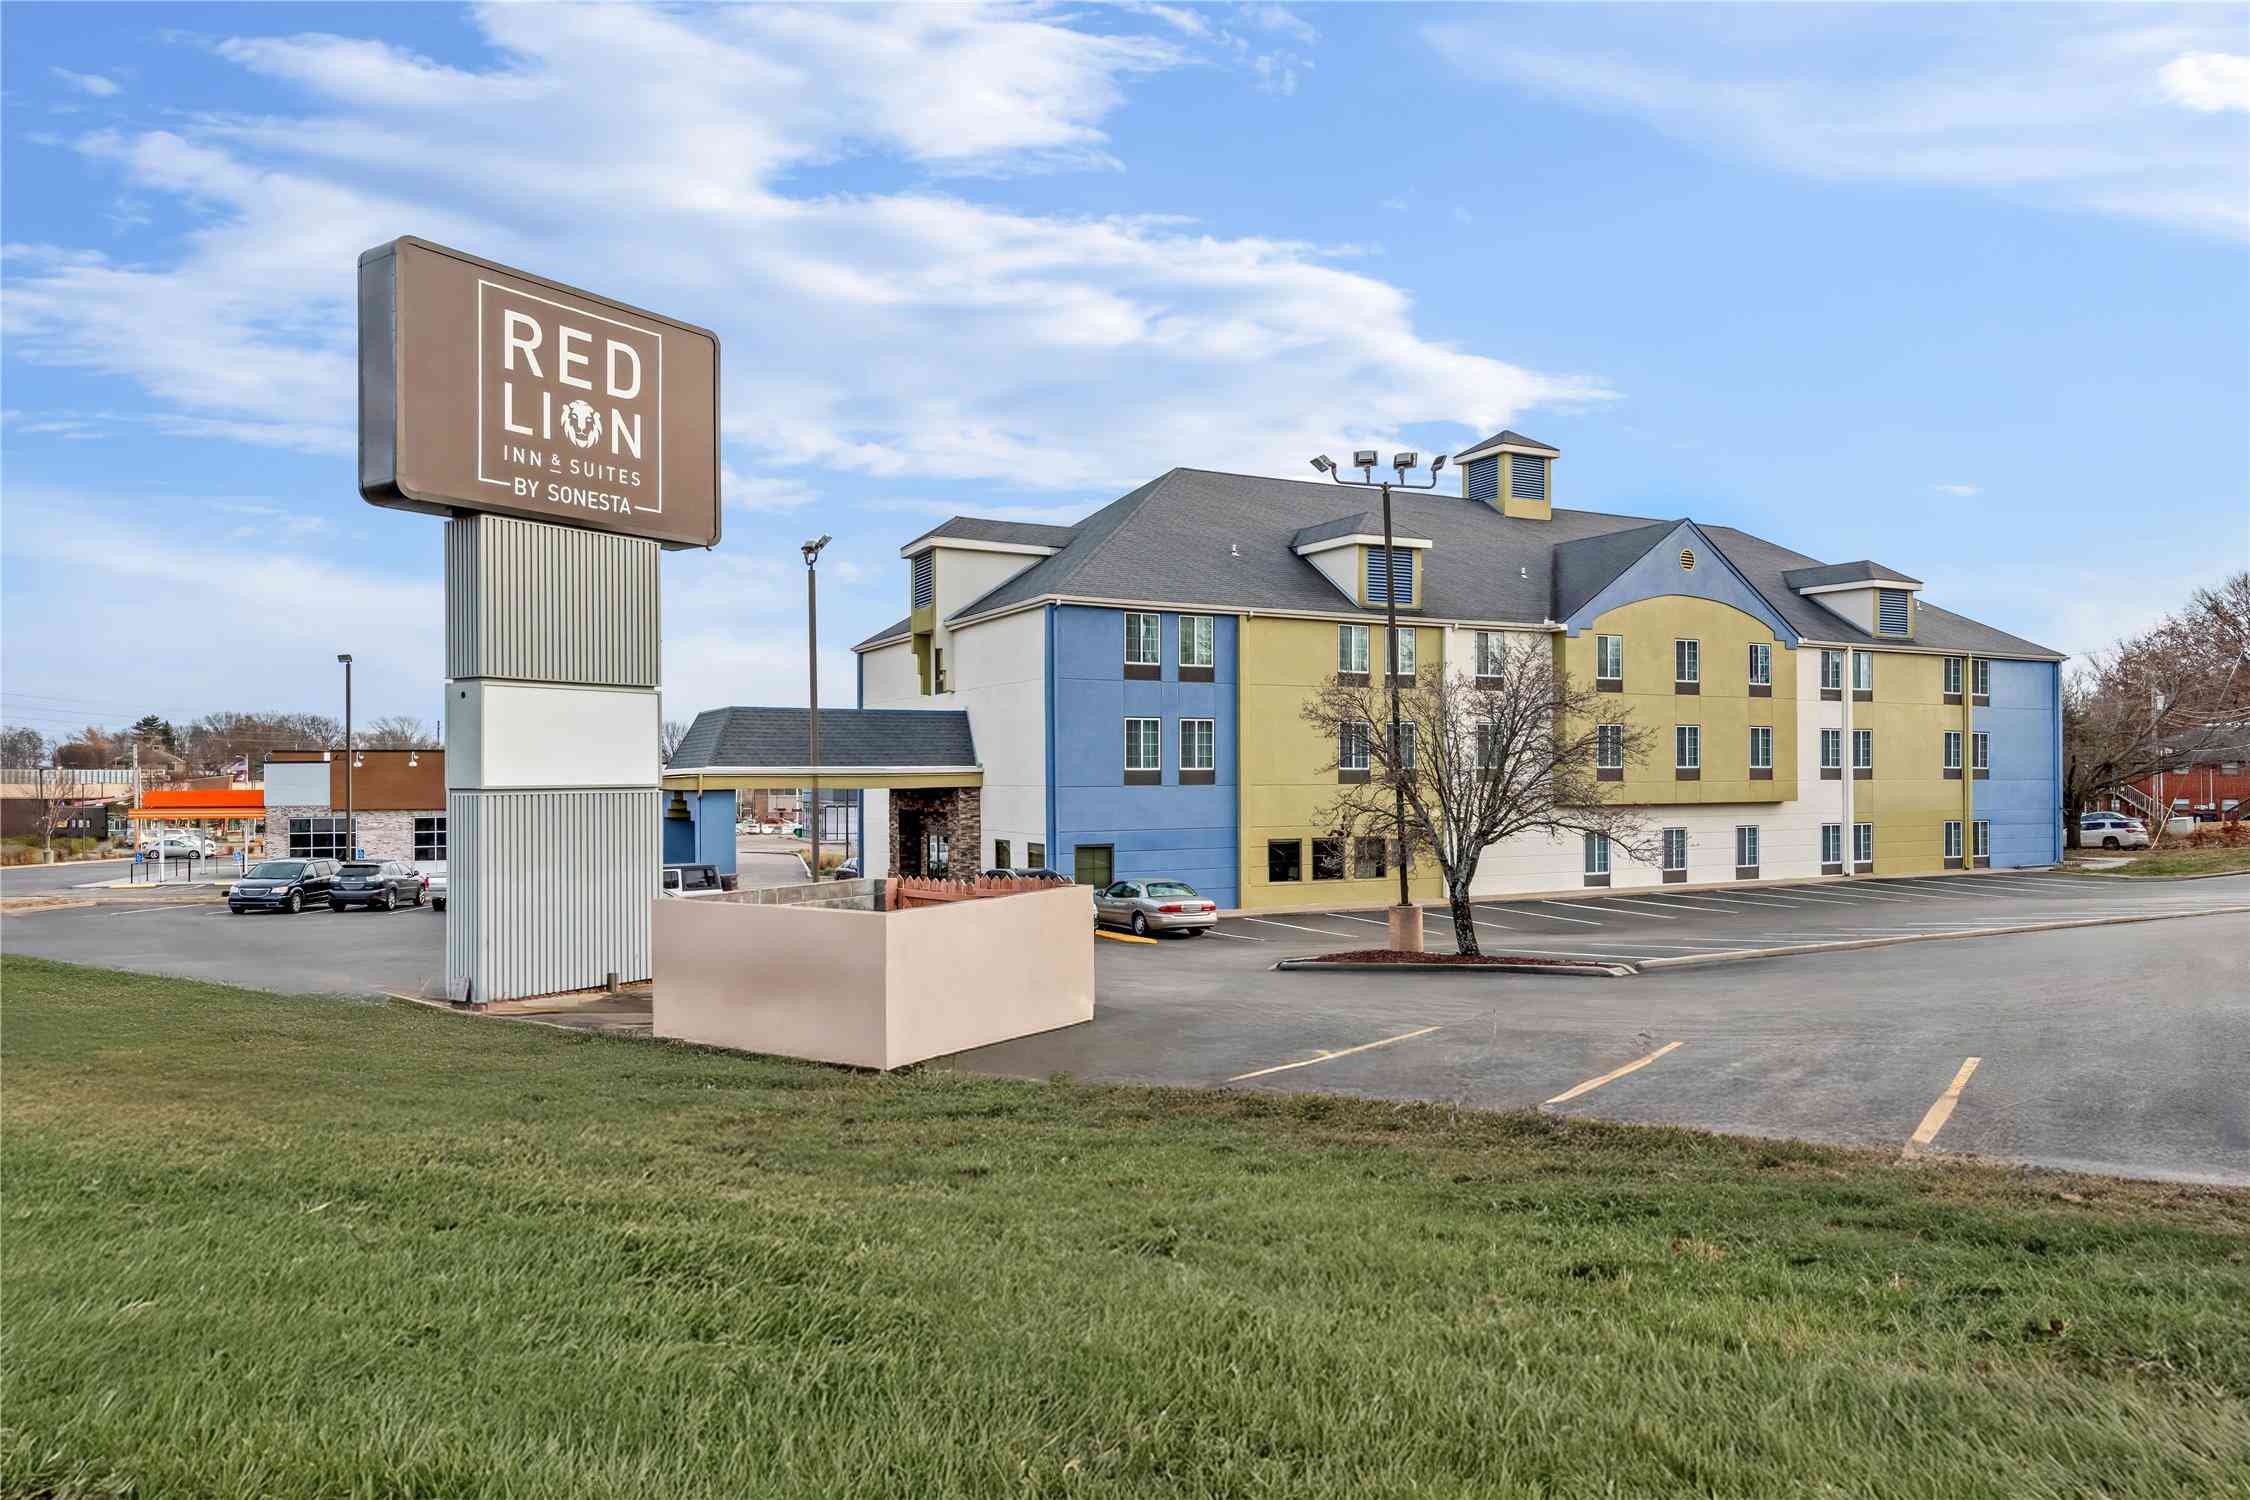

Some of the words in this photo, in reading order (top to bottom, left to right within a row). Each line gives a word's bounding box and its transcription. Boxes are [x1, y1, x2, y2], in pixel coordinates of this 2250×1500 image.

[504, 309, 641, 399] RED
[504, 445, 542, 467] INN
[550, 453, 561, 470] &
[570, 460, 641, 487] SUITES
[514, 477, 540, 498] BY
[547, 483, 632, 515] SONESTA
